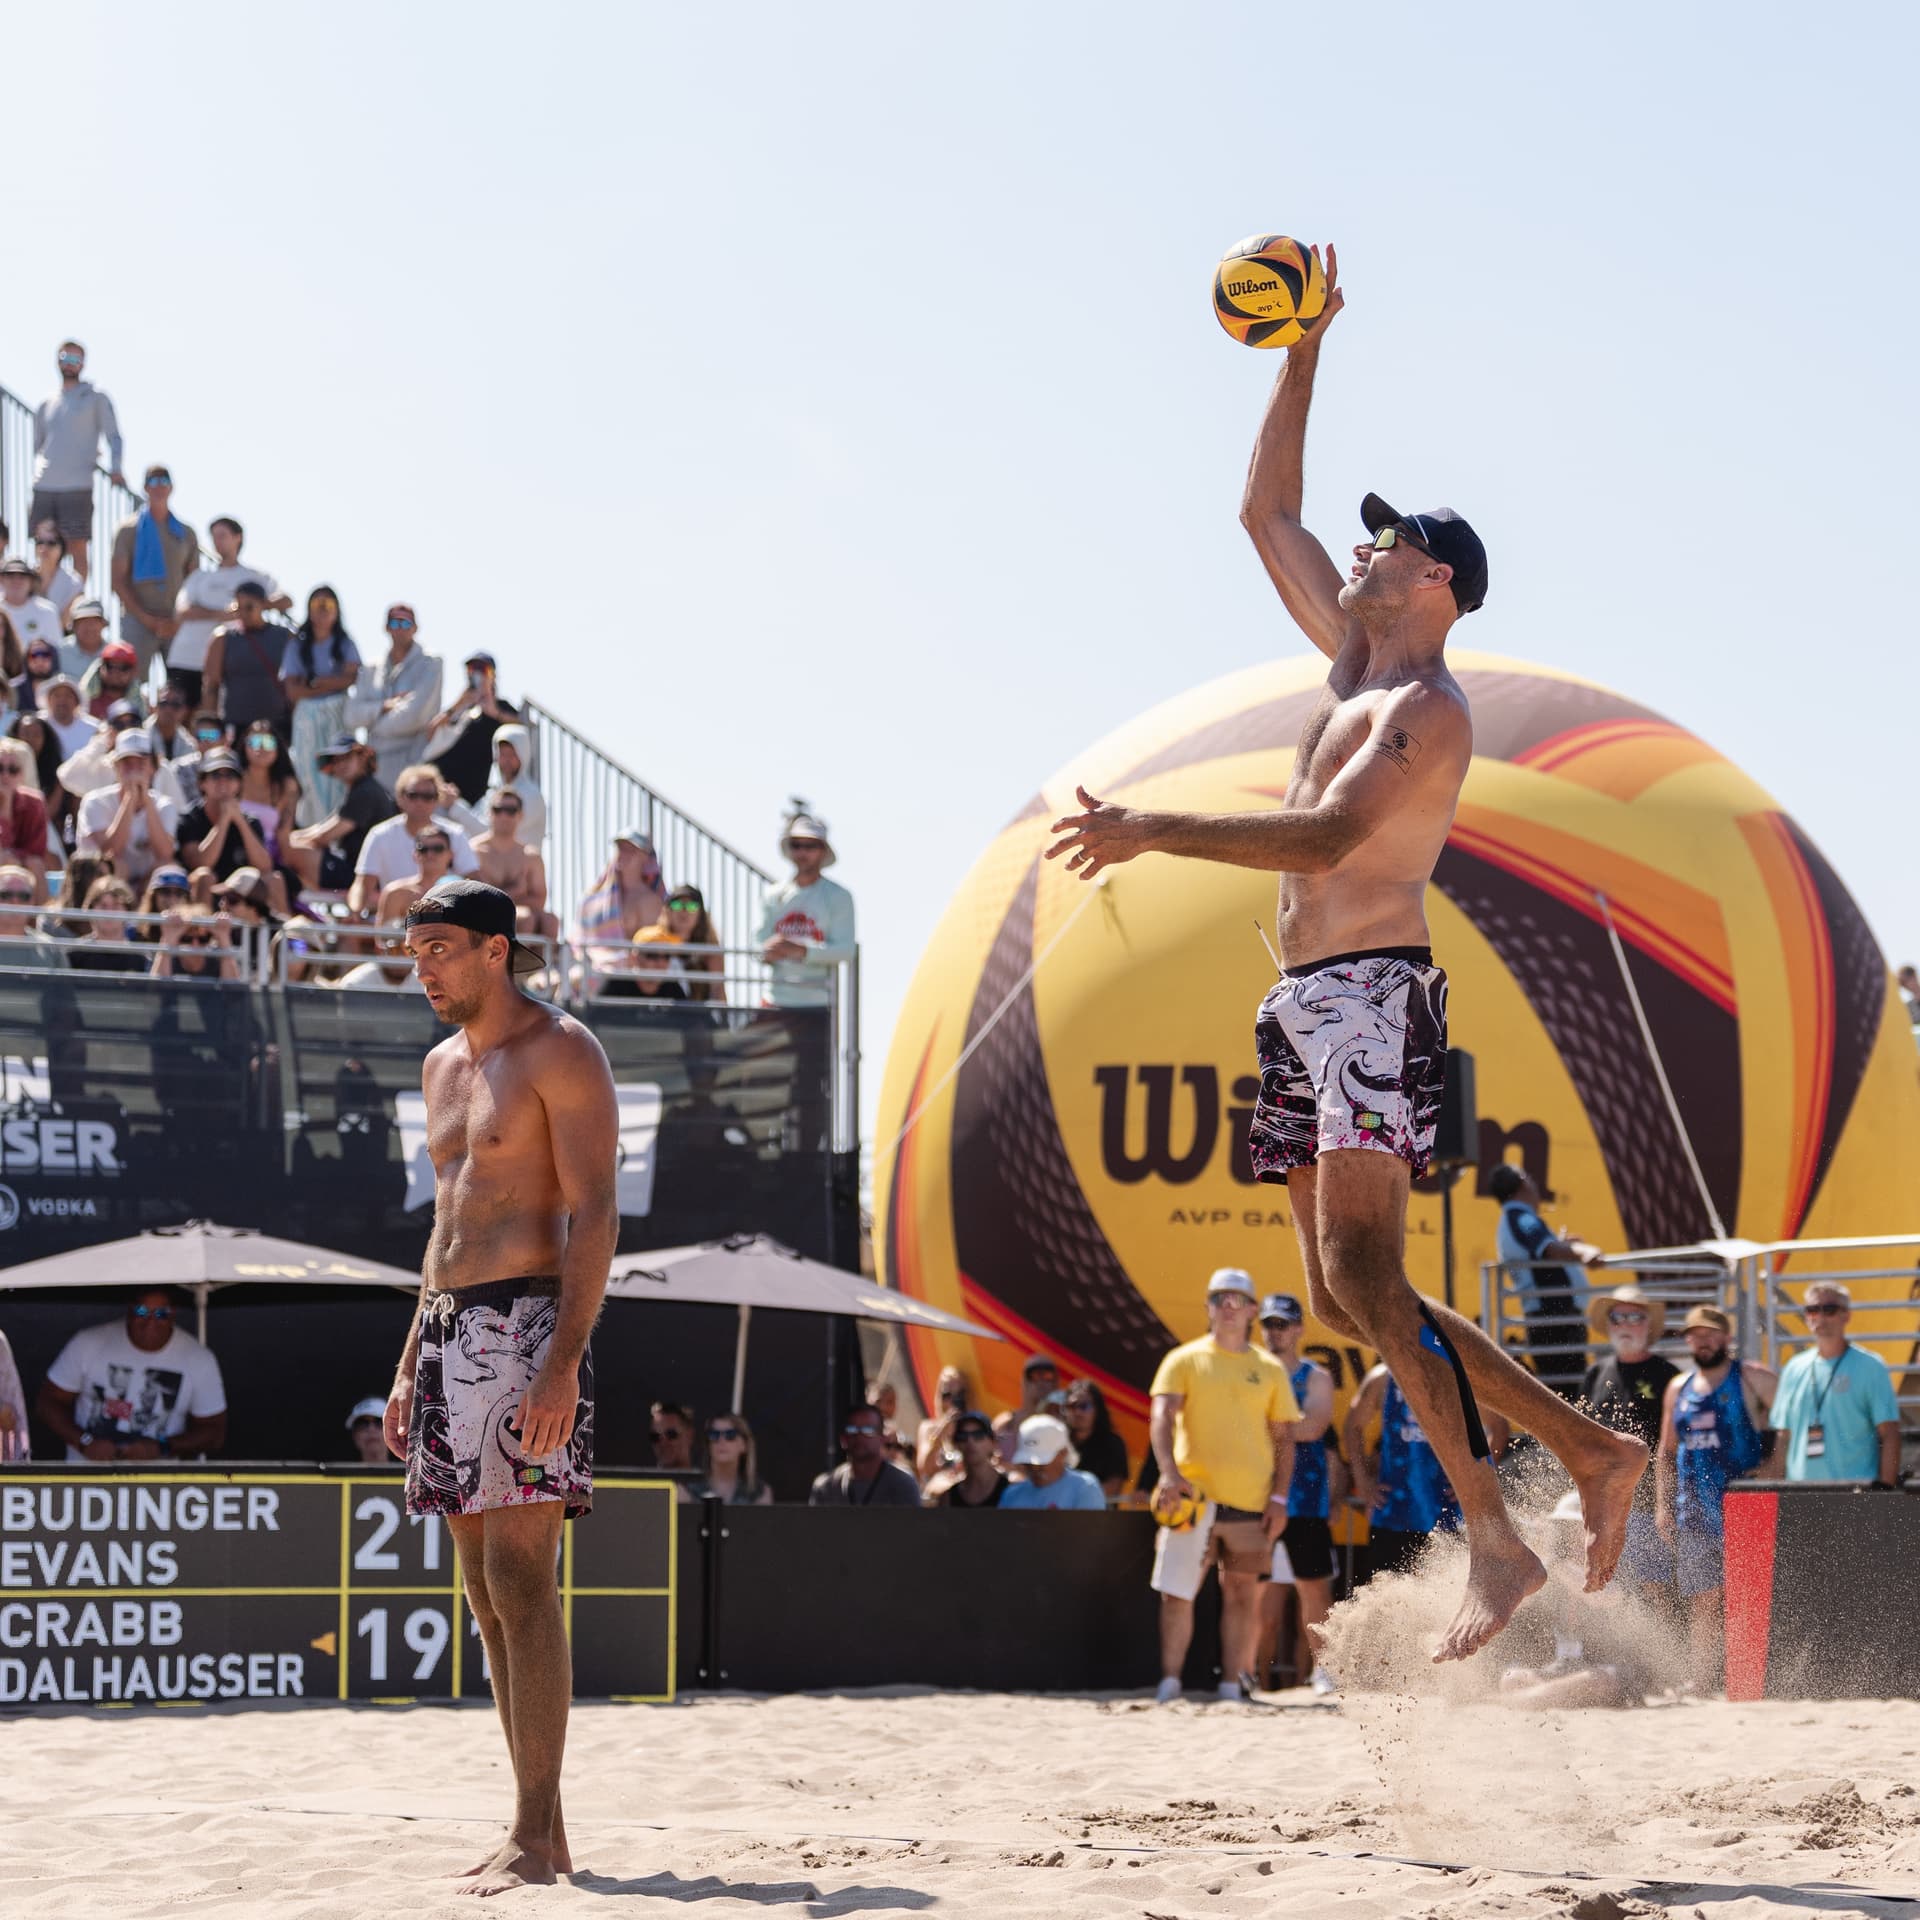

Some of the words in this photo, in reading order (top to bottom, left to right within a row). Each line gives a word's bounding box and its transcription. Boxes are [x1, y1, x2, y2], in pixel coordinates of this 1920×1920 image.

[1228, 279, 1280, 297] Wilson
[28, 1197, 97, 1216] VODKA
[1169, 1209, 1231, 1227] AVP
[2, 1487, 281, 1531] BUDINGER
[354, 1496, 440, 1571] 21
[2, 1541, 179, 1587] EVANS
[0, 1601, 184, 1648] CRABB
[358, 1607, 450, 1681] 19
[0, 1653, 305, 1702] DALHAUSSER
